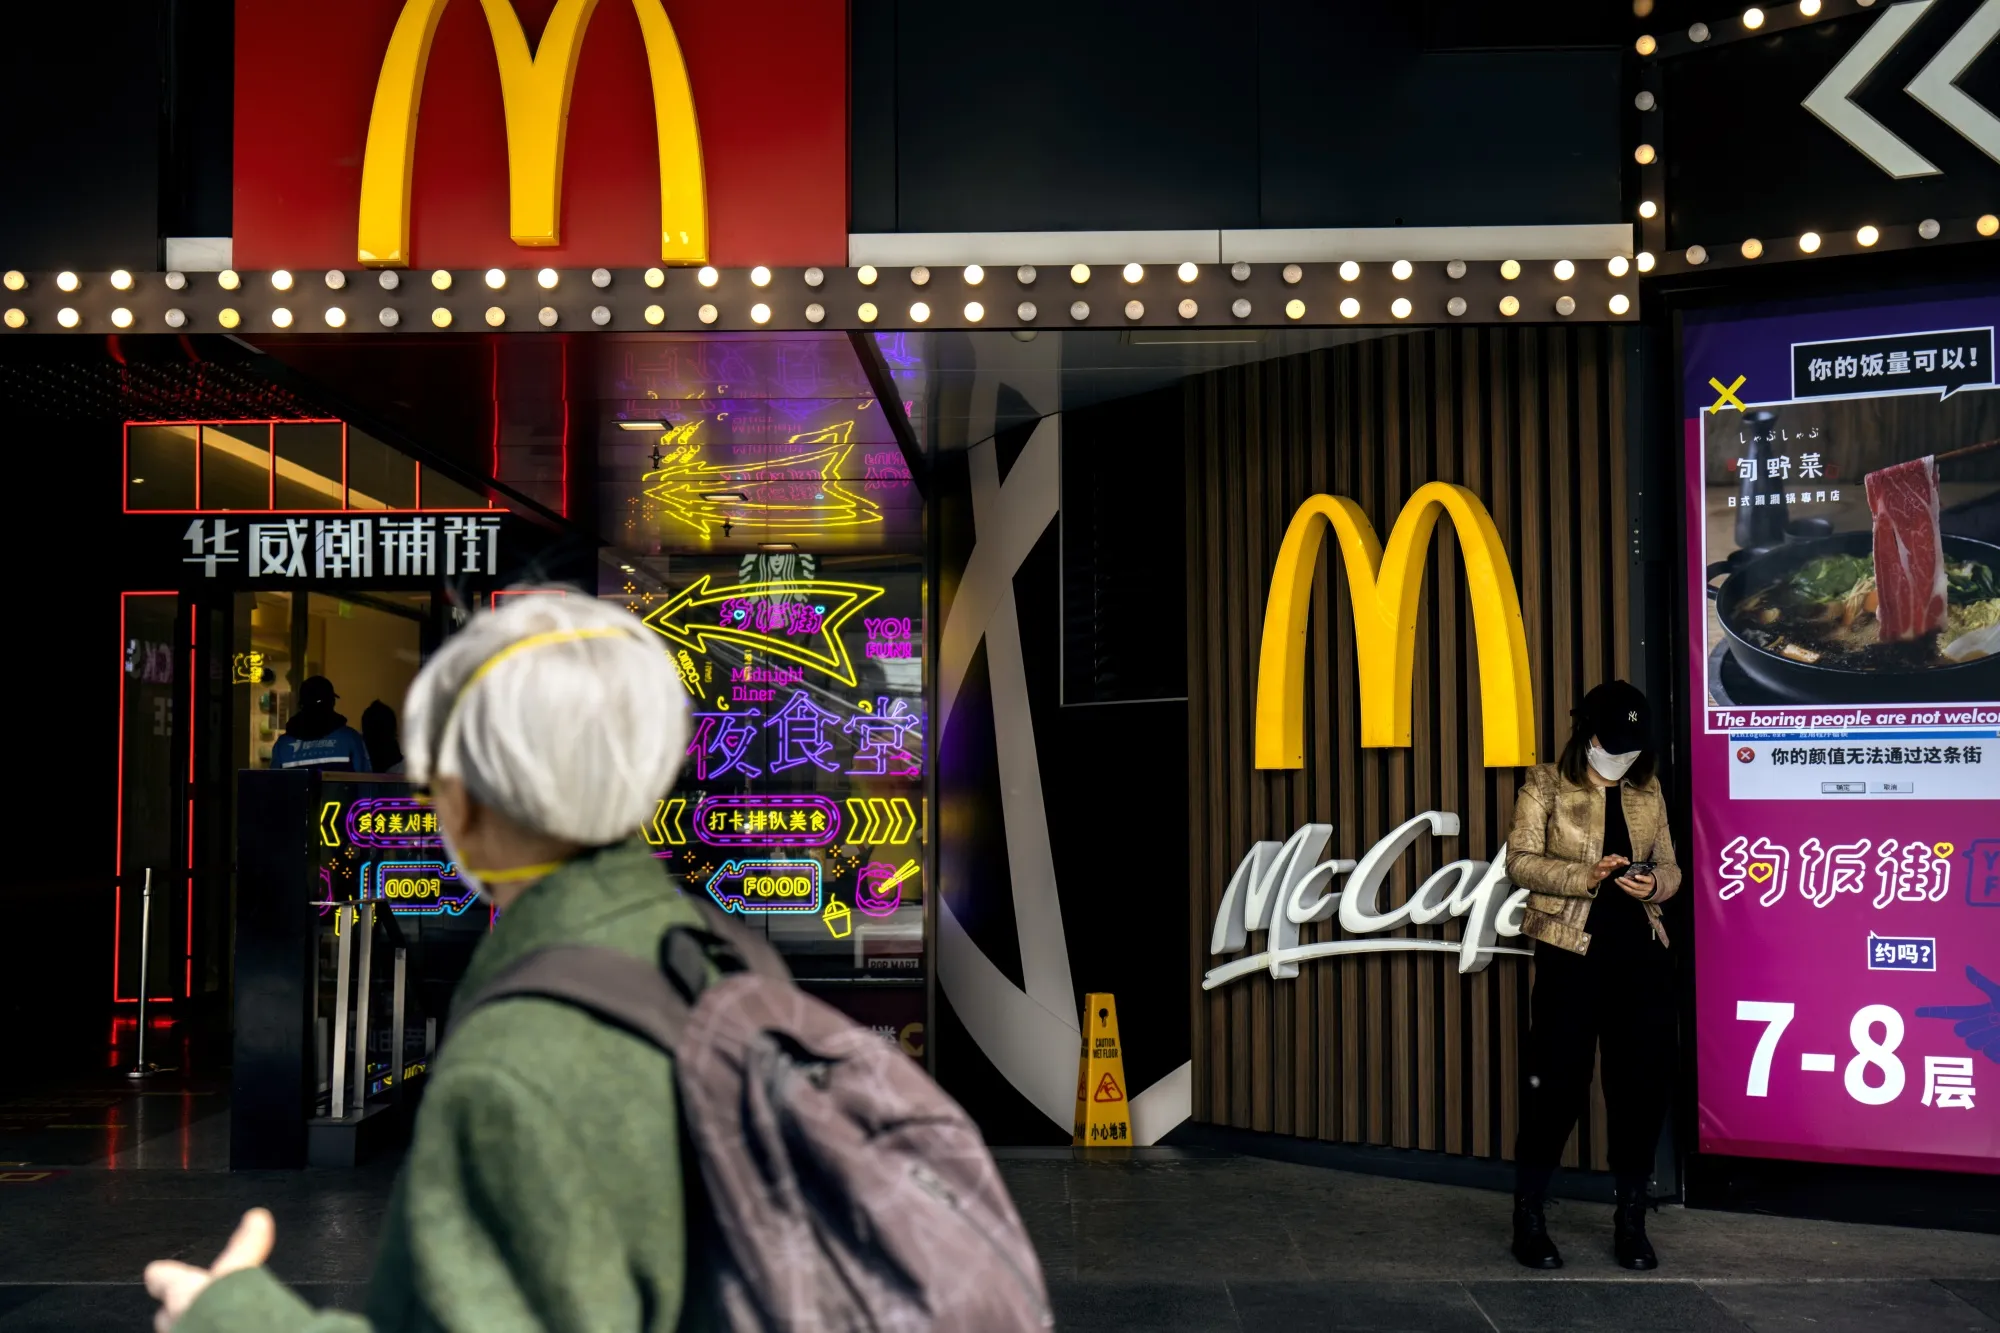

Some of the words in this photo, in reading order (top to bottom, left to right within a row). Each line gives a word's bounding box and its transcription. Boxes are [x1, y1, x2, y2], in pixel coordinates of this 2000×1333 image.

[1808, 347, 1978, 381] 你的饭量可以!
[183, 517, 501, 578] 华威潮铺街
[864, 617, 912, 640] YO!
[730, 665, 804, 686] Midnight
[732, 686, 776, 701] Diner
[1715, 711, 1746, 727] The
[1750, 711, 1806, 729] boring
[1810, 710, 1871, 729] people
[1876, 713, 1906, 725] are
[1911, 711, 1941, 724] not
[1944, 708, 2000, 723] welco
[1771, 746, 1982, 765] 你的颜值无法通过这条街
[708, 810, 827, 831] 打卡排队美食
[1719, 836, 1951, 909] 约饭街
[743, 876, 811, 897] FOOD
[1875, 943, 1931, 964] 约吗?
[1095, 1038, 1116, 1048] CAUTION
[1091, 1122, 1128, 1140] 小心地滑
